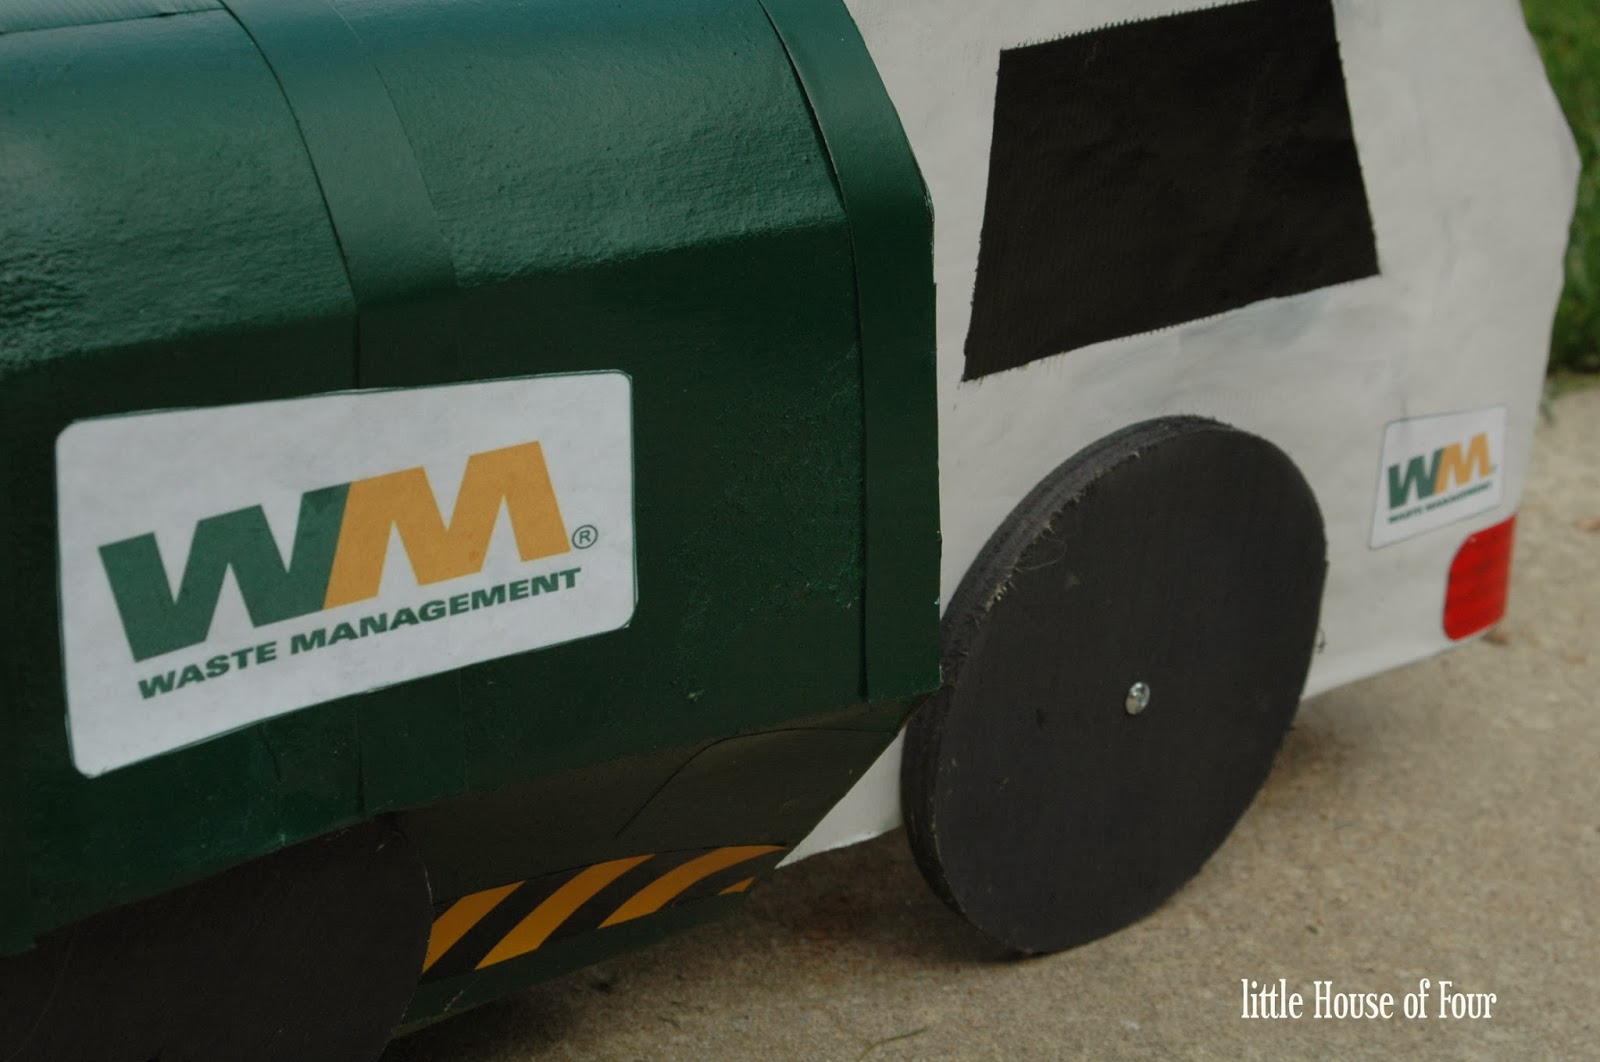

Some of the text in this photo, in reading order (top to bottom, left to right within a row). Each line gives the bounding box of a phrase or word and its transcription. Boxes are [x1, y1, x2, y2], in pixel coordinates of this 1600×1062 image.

[1388, 431, 1490, 510] WM
[98, 440, 571, 662] WM
[138, 568, 582, 699] WASTE MANAGEMENT
